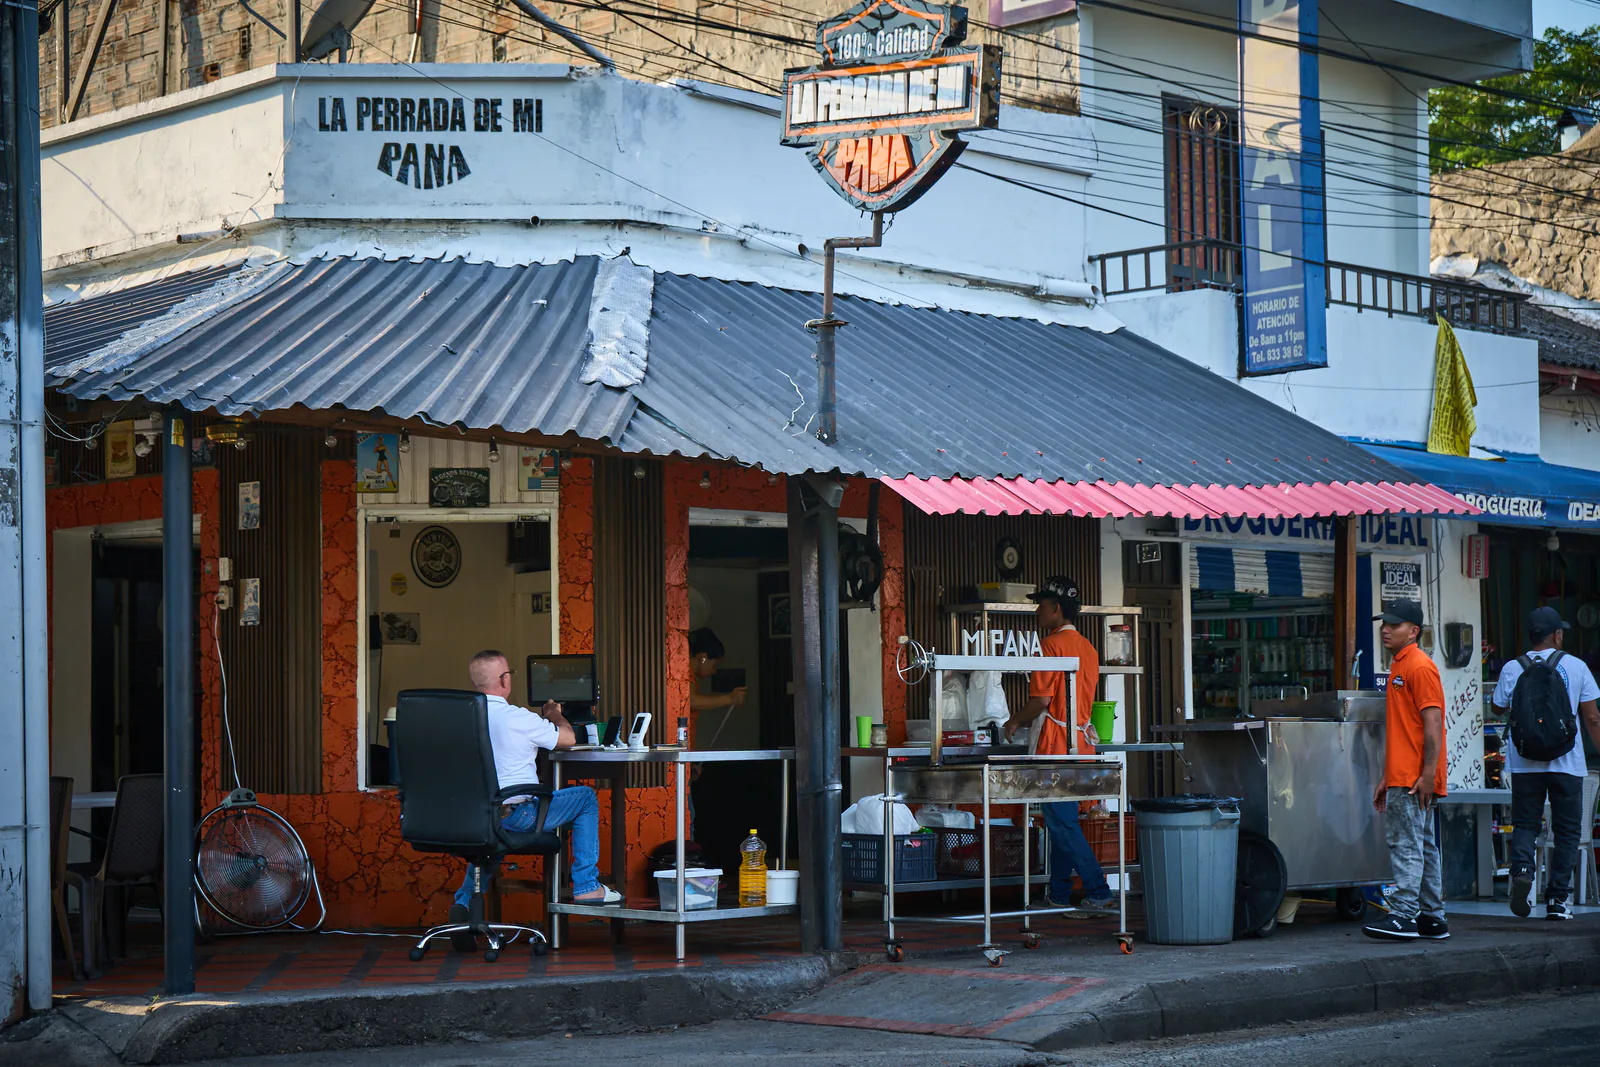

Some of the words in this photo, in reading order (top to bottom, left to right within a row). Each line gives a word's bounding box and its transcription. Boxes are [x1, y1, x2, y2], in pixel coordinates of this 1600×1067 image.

[837, 31, 873, 60] 100%
[876, 24, 929, 56] Calidad
[318, 97, 348, 132] LA
[356, 96, 467, 132] PERRADA
[474, 97, 503, 133] DE
[512, 98, 543, 133] MI
[377, 142, 472, 190] PANA
[832, 134, 913, 193] PANA
[1252, 298, 1287, 315] HORARIO
[1288, 295, 1299, 309] DE
[1256, 311, 1296, 331] ATENCIÓN
[1249, 334, 1259, 348] De
[1260, 333, 1276, 346] 8am
[1277, 335, 1283, 344] a
[1284, 329, 1305, 344] 11pm
[1251, 350, 1266, 364] Tel.
[1266, 348, 1281, 361] 833
[1282, 346, 1292, 359] 38
[1293, 344, 1303, 357] 62
[430, 470, 458, 484] LEGENDS
[477, 474, 489, 484] DIE
[1361, 514, 1428, 547] IDEAL
[1385, 571, 1417, 586] IDEAL
[962, 628, 985, 657] MI
[989, 629, 1044, 657] PANA
[1376, 677, 1386, 687] SU
